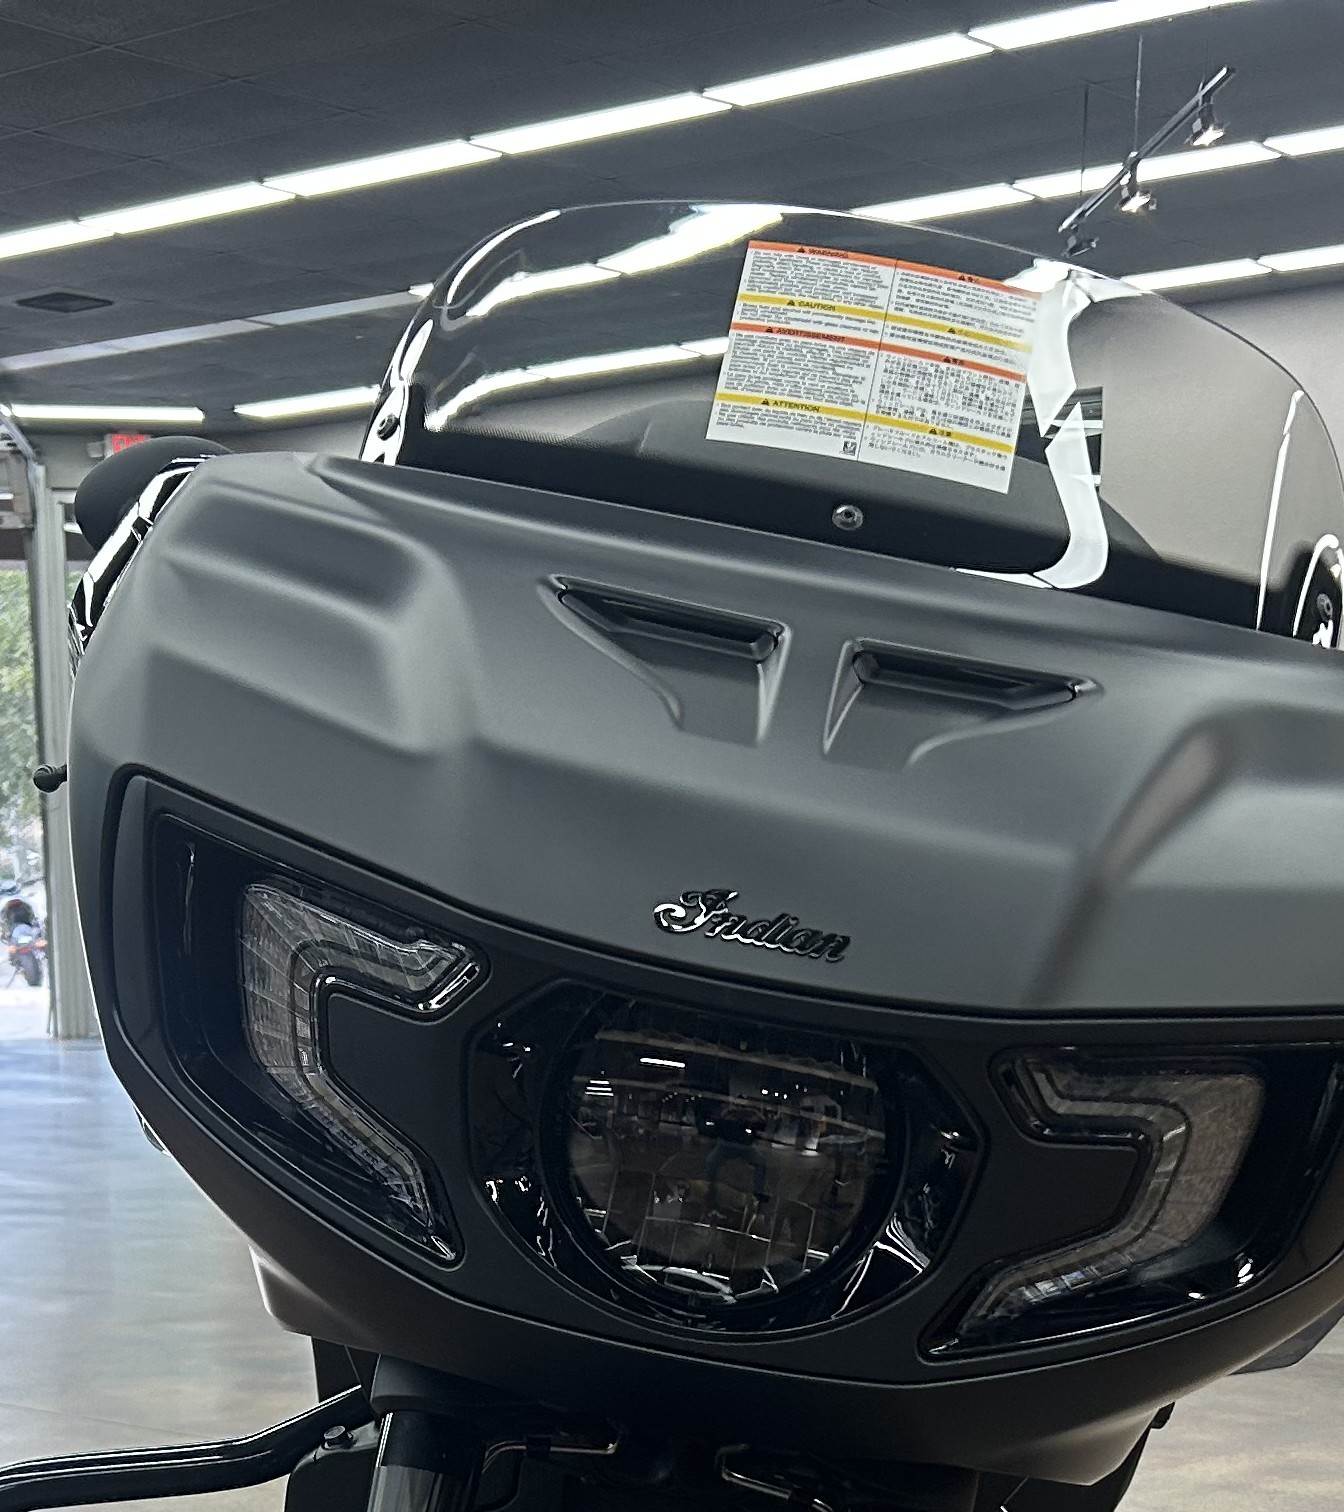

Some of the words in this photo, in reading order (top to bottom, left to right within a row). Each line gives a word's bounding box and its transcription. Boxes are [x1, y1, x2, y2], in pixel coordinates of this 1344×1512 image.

[798, 301, 836, 312] CAUTION
[772, 400, 821, 413] ATTENTION
[653, 888, 851, 964] Indian
